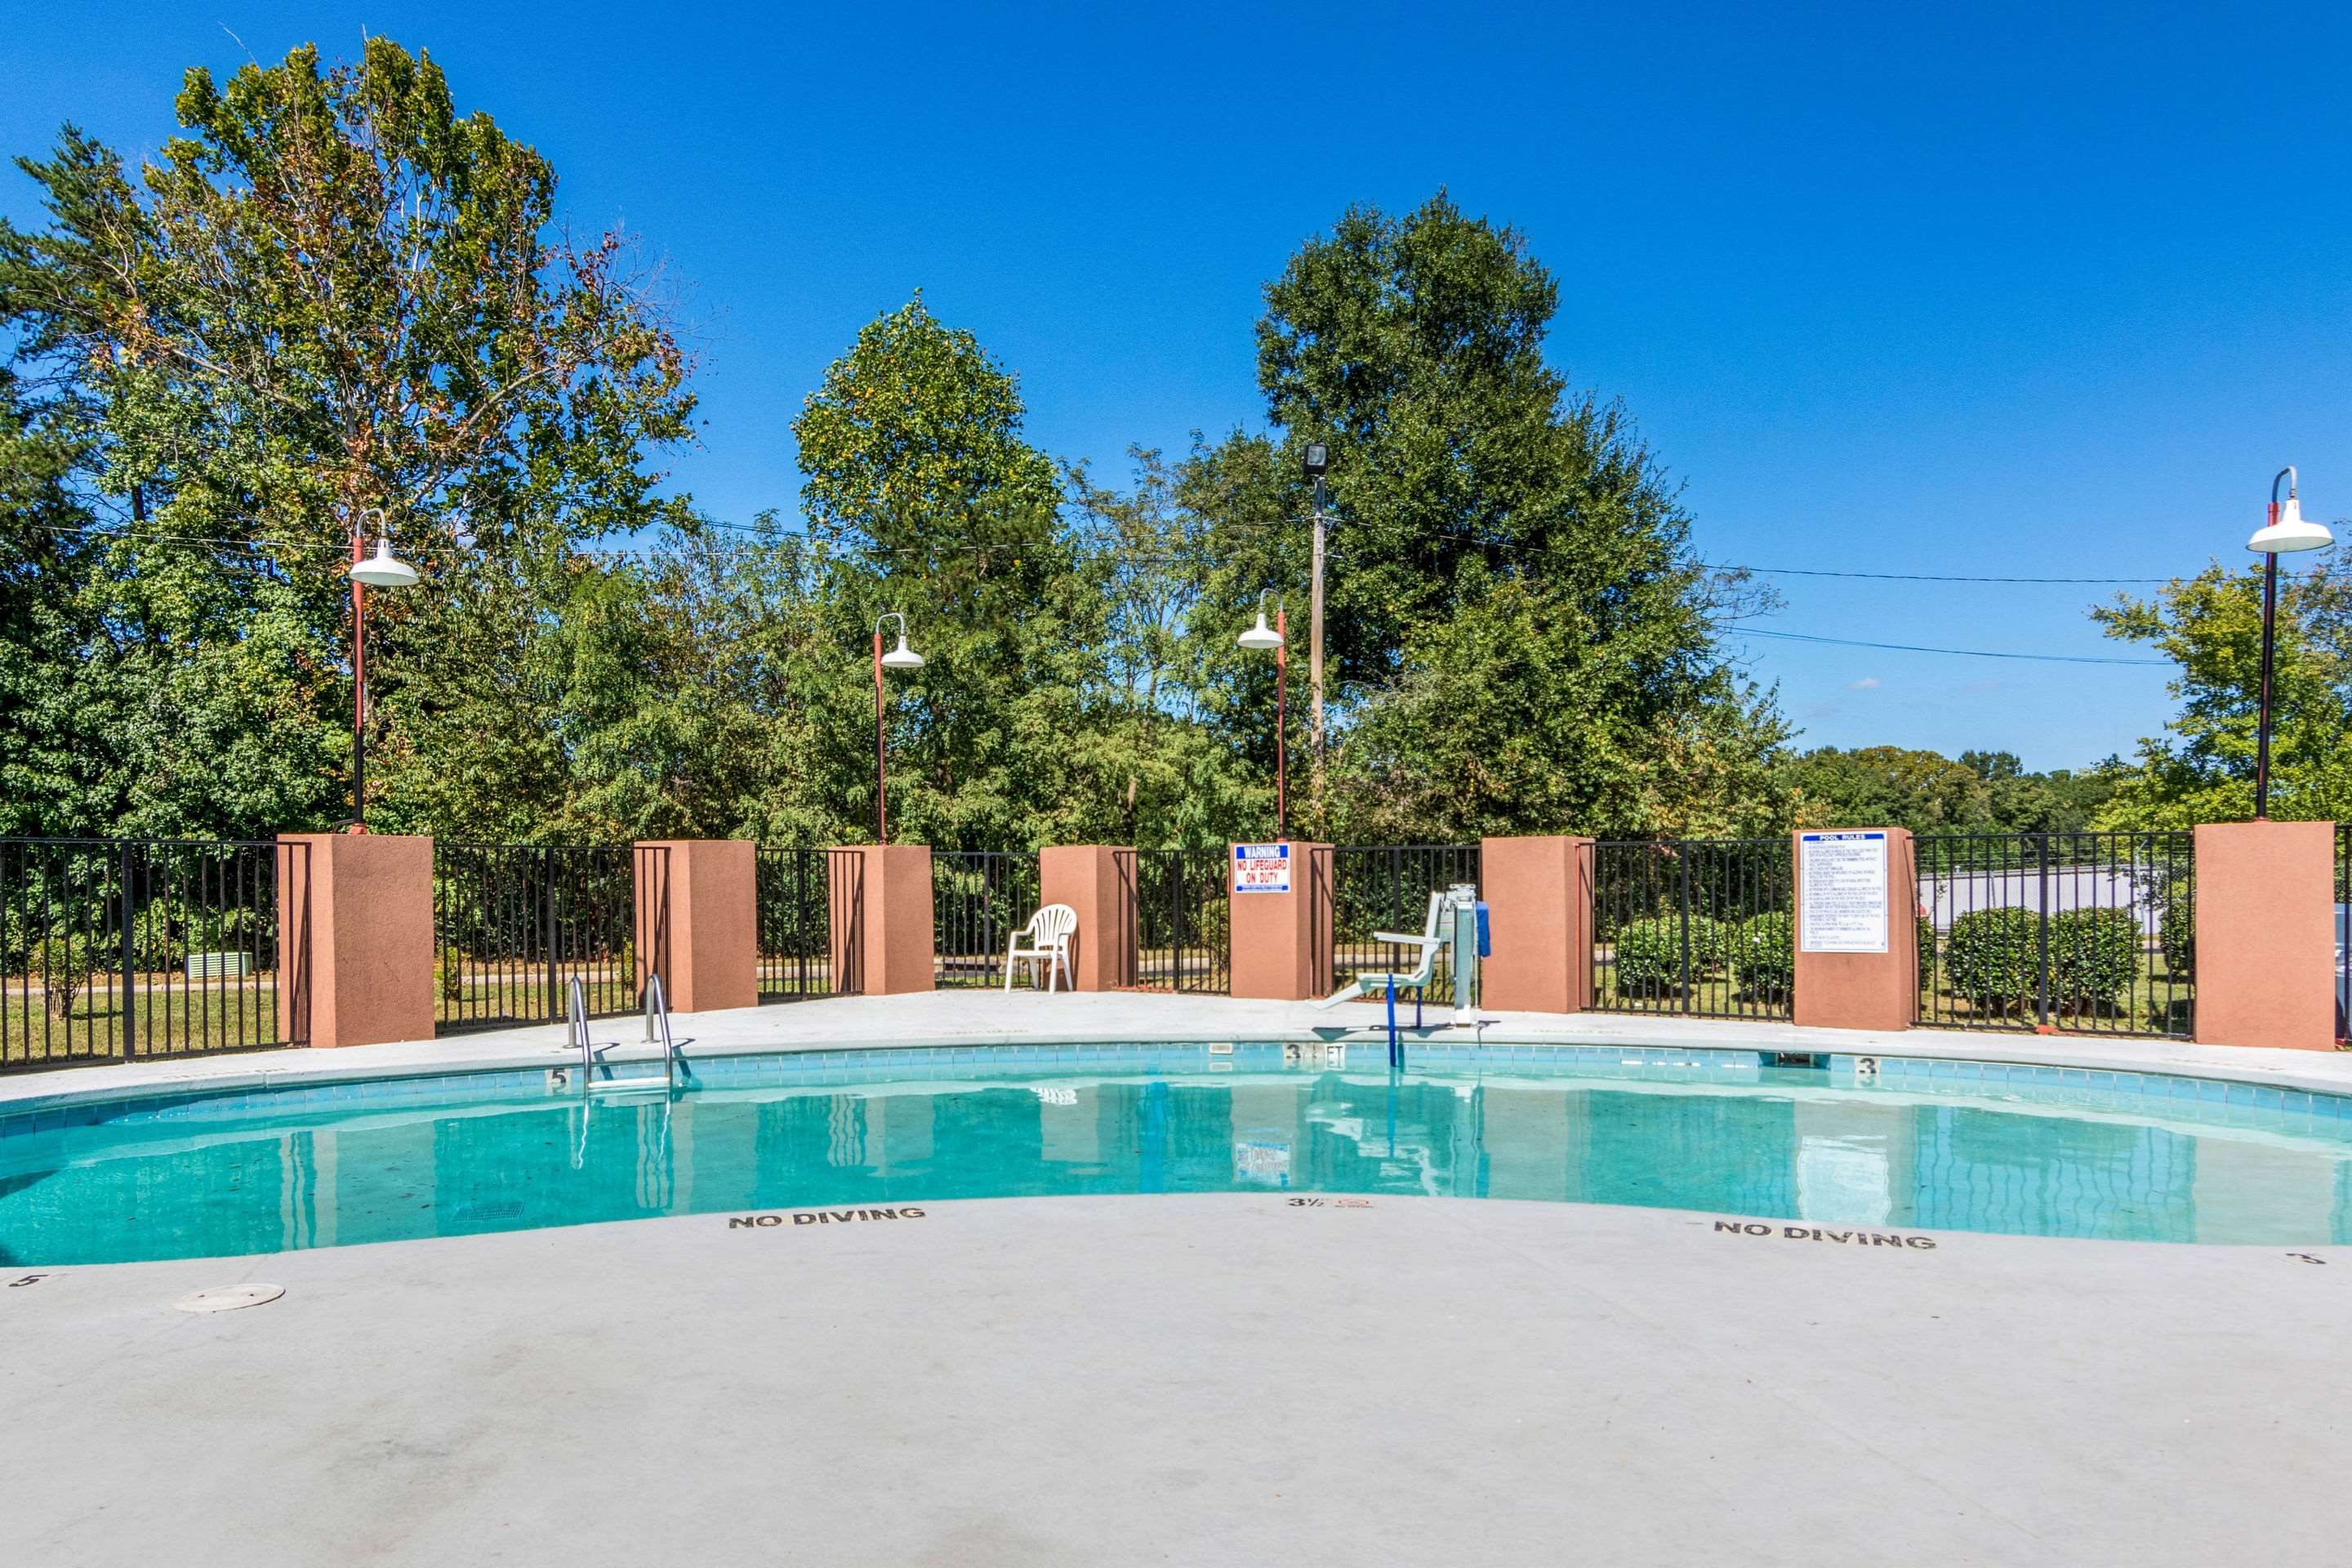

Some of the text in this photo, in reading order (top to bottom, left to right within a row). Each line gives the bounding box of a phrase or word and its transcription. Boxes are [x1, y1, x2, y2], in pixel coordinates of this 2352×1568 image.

[1244, 846, 1281, 858] WARNING
[1237, 859, 1286, 871] NO LIFEGUARD
[1246, 872, 1278, 883] ON DUTY
[551, 1068, 567, 1085] 5
[729, 1208, 925, 1228] NO DIVING
[1715, 1222, 1937, 1250] NO DIVING
[8, 1274, 49, 1287] 5
